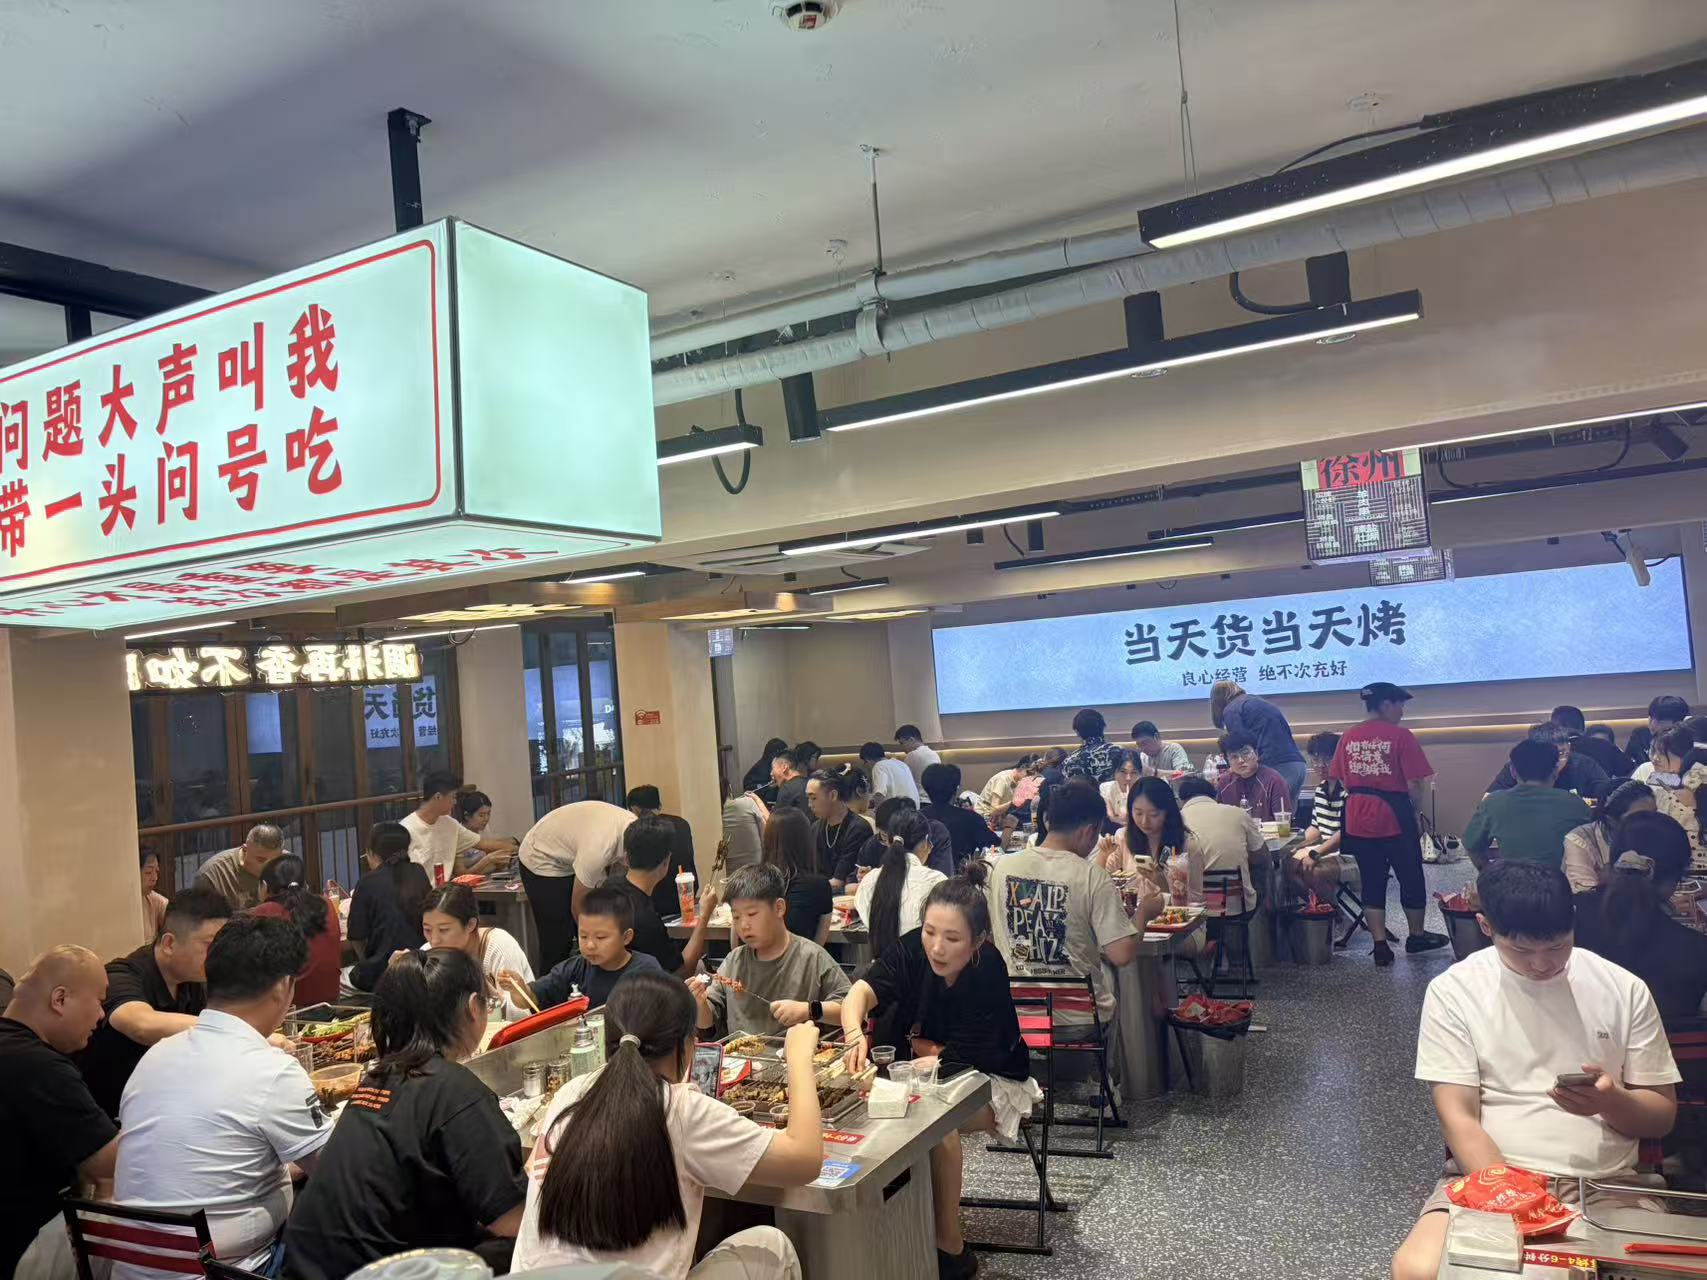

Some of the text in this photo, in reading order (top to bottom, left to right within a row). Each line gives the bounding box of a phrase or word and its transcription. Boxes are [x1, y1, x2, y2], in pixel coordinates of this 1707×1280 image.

[0, 304, 338, 474] 问题大声叫我
[0, 407, 342, 557] 带一头问号吃
[1320, 450, 1400, 489] 徐州
[1124, 600, 1406, 665] 当天货当天烤
[1182, 660, 1347, 687] 良心经营 绝不次充好
